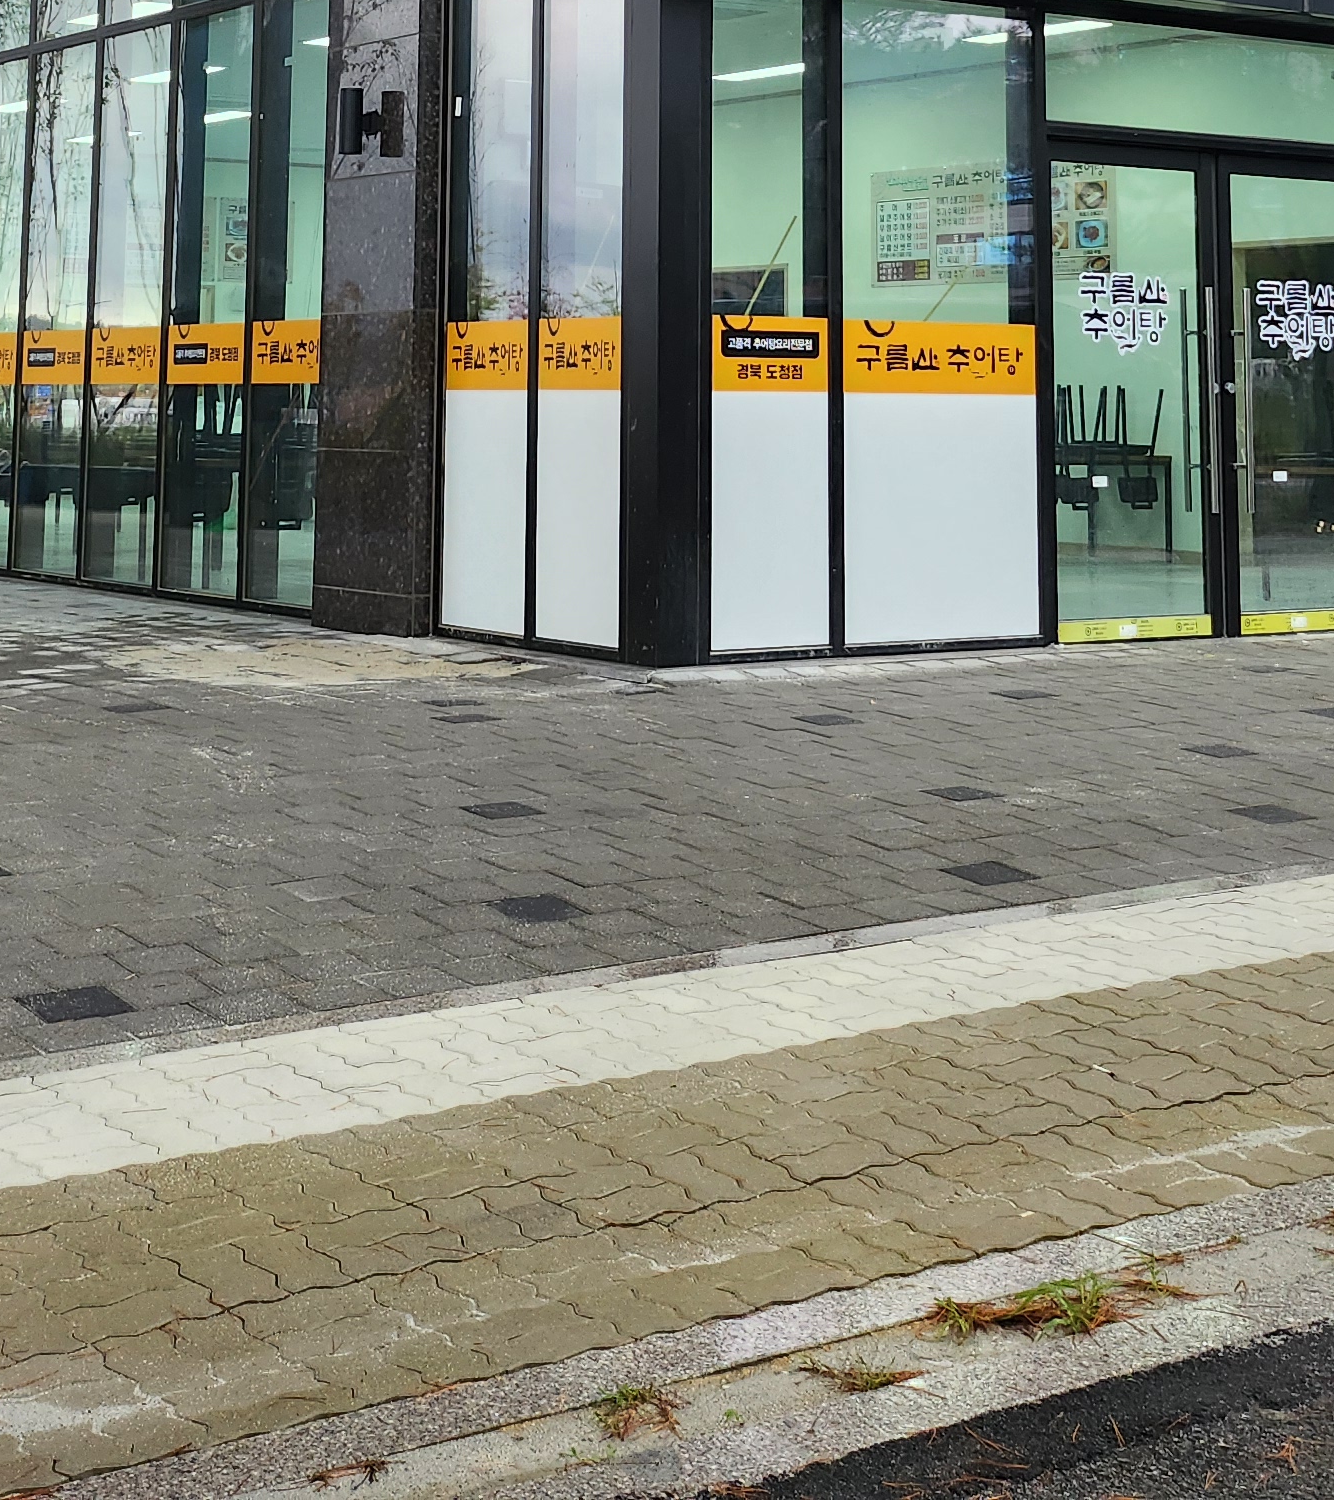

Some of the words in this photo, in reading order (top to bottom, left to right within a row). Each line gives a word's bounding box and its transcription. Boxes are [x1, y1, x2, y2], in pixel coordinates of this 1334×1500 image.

[1079, 273, 1167, 305] 구름산
[1081, 309, 1167, 345] 추어탕
[95, 346, 125, 367] 구름산
[127, 344, 157, 369] 추어탕
[257, 340, 293, 364] 구름산
[451, 343, 486, 371] 구름산
[488, 342, 524, 373] 추어탕
[543, 342, 579, 370] 구름산
[581, 339, 616, 372] 추어탕
[856, 344, 940, 372] 구름산
[946, 344, 1024, 376] 추어탕
[736, 363, 762, 380] 경북
[766, 364, 803, 380] 도청점
